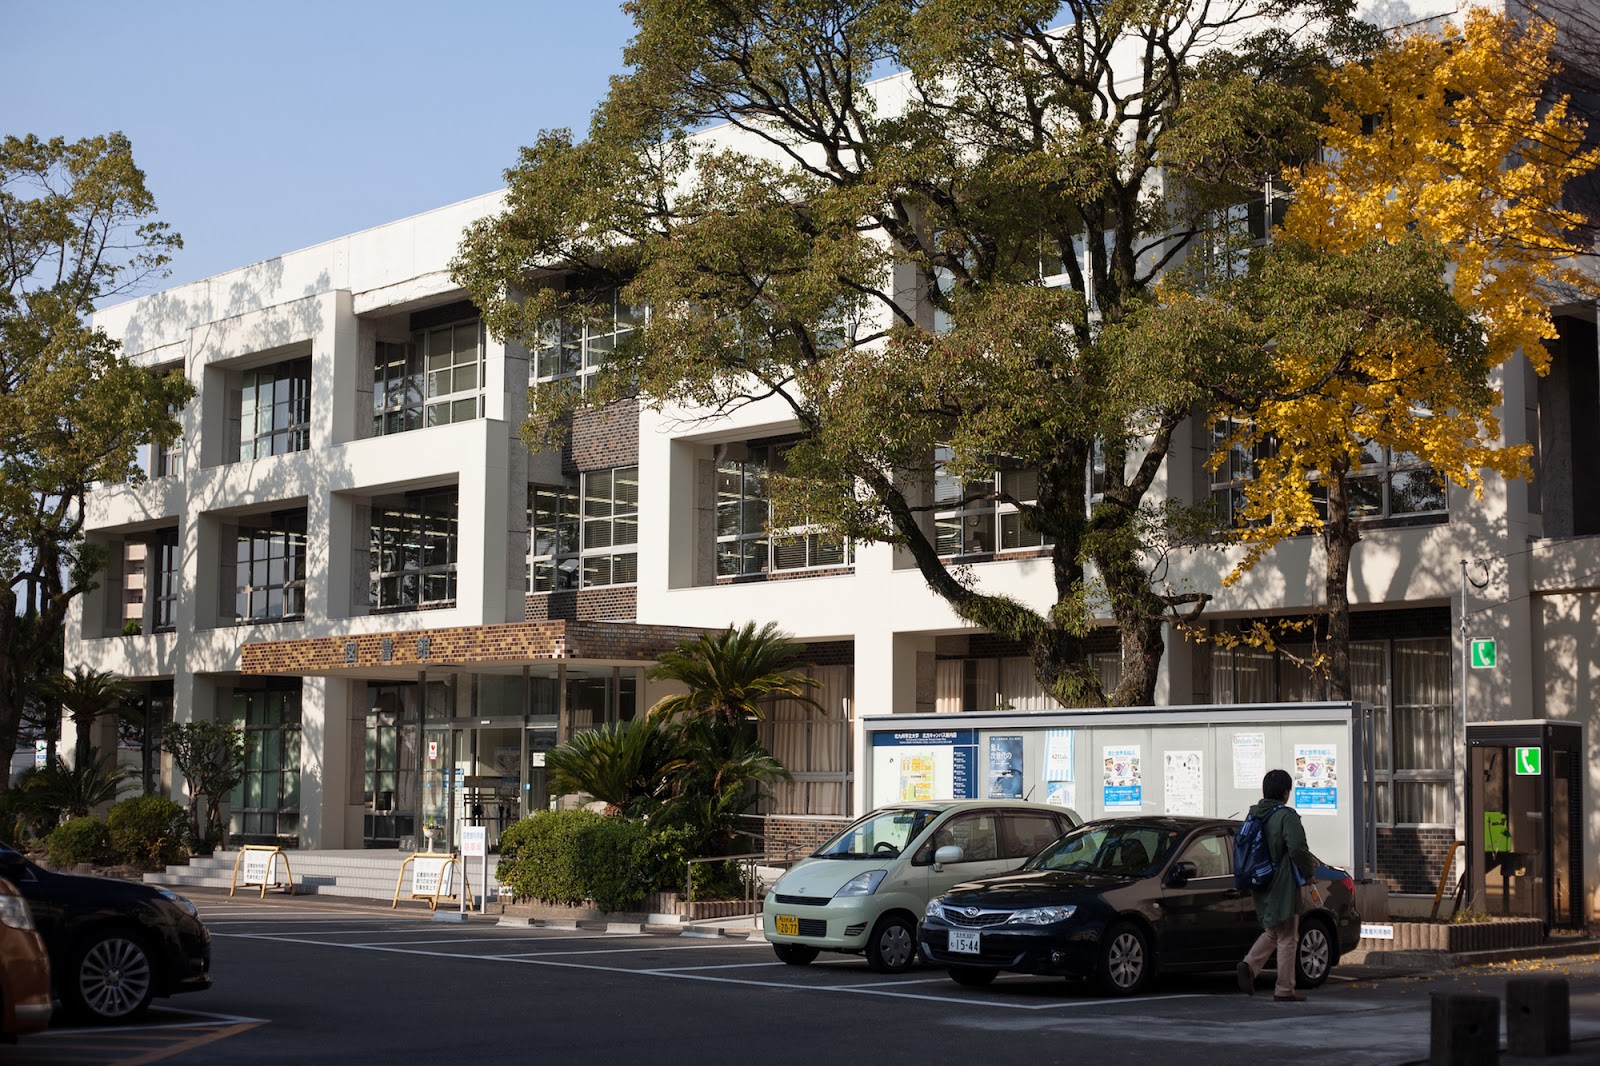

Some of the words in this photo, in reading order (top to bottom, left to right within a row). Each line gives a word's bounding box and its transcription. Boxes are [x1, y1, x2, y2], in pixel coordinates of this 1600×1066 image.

[345, 635, 431, 663] 図書館
[781, 923, 797, 934] 20-77
[956, 939, 978, 952] 15-44
